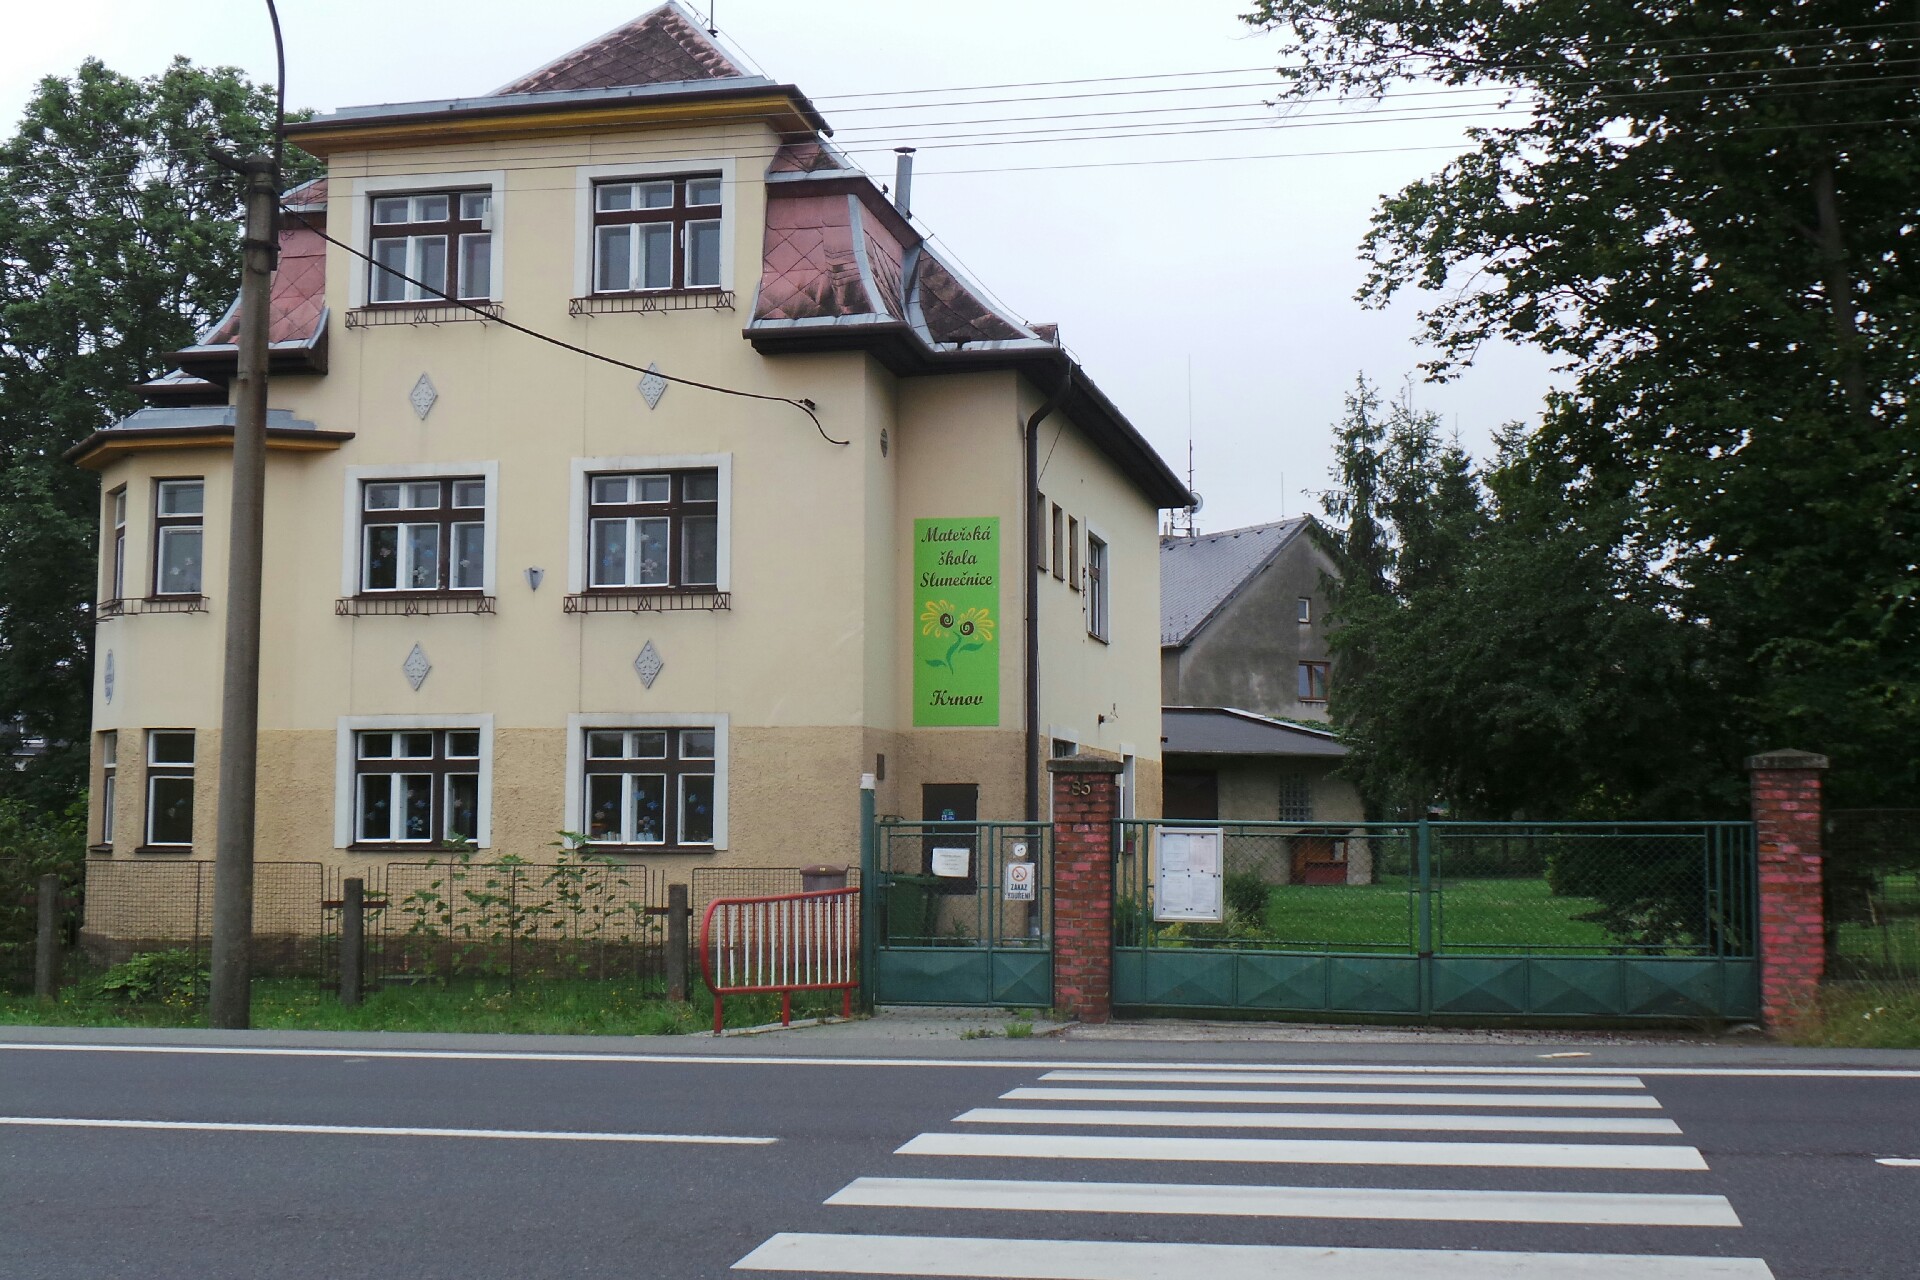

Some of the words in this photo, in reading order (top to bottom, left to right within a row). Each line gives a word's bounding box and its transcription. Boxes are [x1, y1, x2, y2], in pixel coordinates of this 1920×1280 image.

[921, 525, 991, 542] Mateřská
[938, 550, 977, 565] škola
[920, 571, 993, 587] Slunečnice
[930, 690, 983, 705] Krnov
